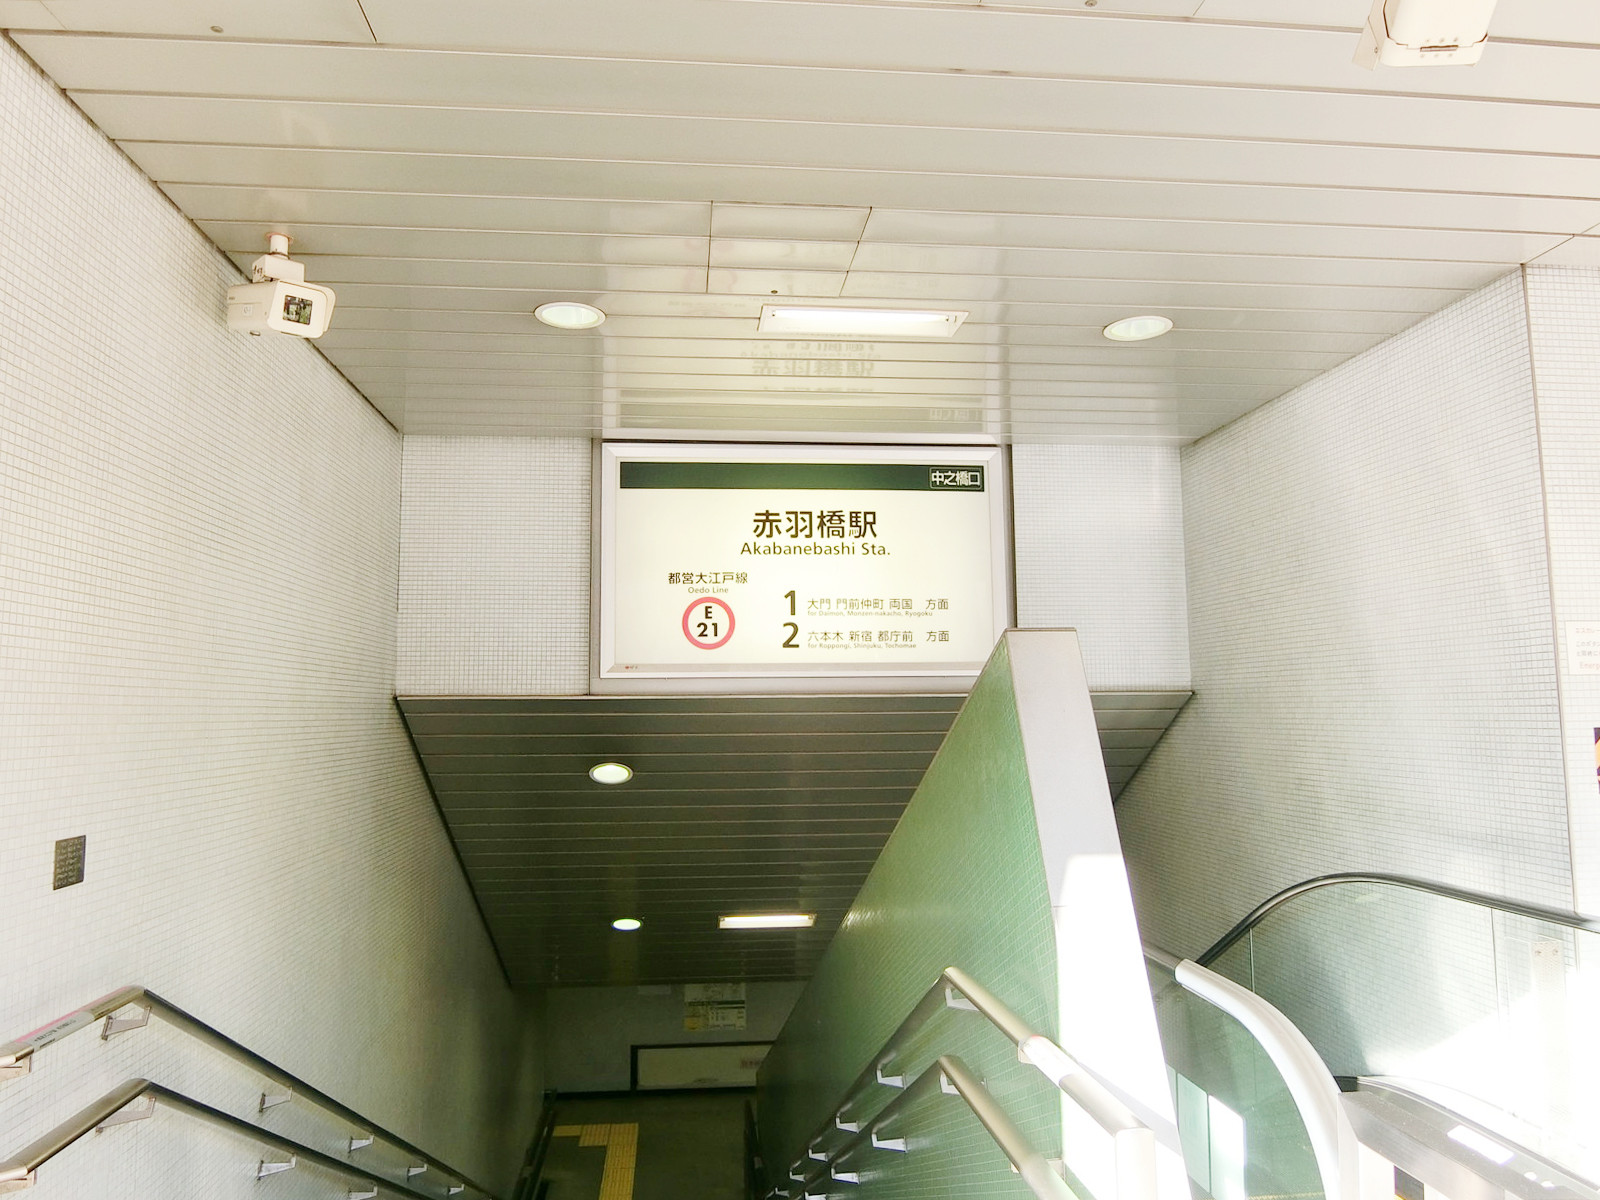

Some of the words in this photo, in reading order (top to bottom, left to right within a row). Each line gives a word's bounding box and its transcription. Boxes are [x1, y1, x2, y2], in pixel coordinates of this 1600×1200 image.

[931, 470, 981, 487] 中之橋口
[753, 510, 877, 538] 赤羽橋駅
[741, 542, 855, 555] Akabanebashi
[862, 543, 890, 555] Sta.
[668, 572, 748, 584] 都営大江戸線
[687, 586, 711, 594] Oedo
[712, 586, 729, 594] Line
[784, 590, 795, 615] 1
[808, 599, 831, 610] 大門
[837, 599, 884, 610] 門前仲町
[890, 599, 912, 610] 両国
[926, 599, 948, 610] 方面
[705, 606, 713, 619] E
[697, 622, 718, 637] 21
[782, 622, 799, 648] 2
[808, 632, 843, 641] 六本木
[849, 631, 872, 642] 新宿
[878, 631, 912, 642] 都庁前
[927, 631, 949, 642] 方面
